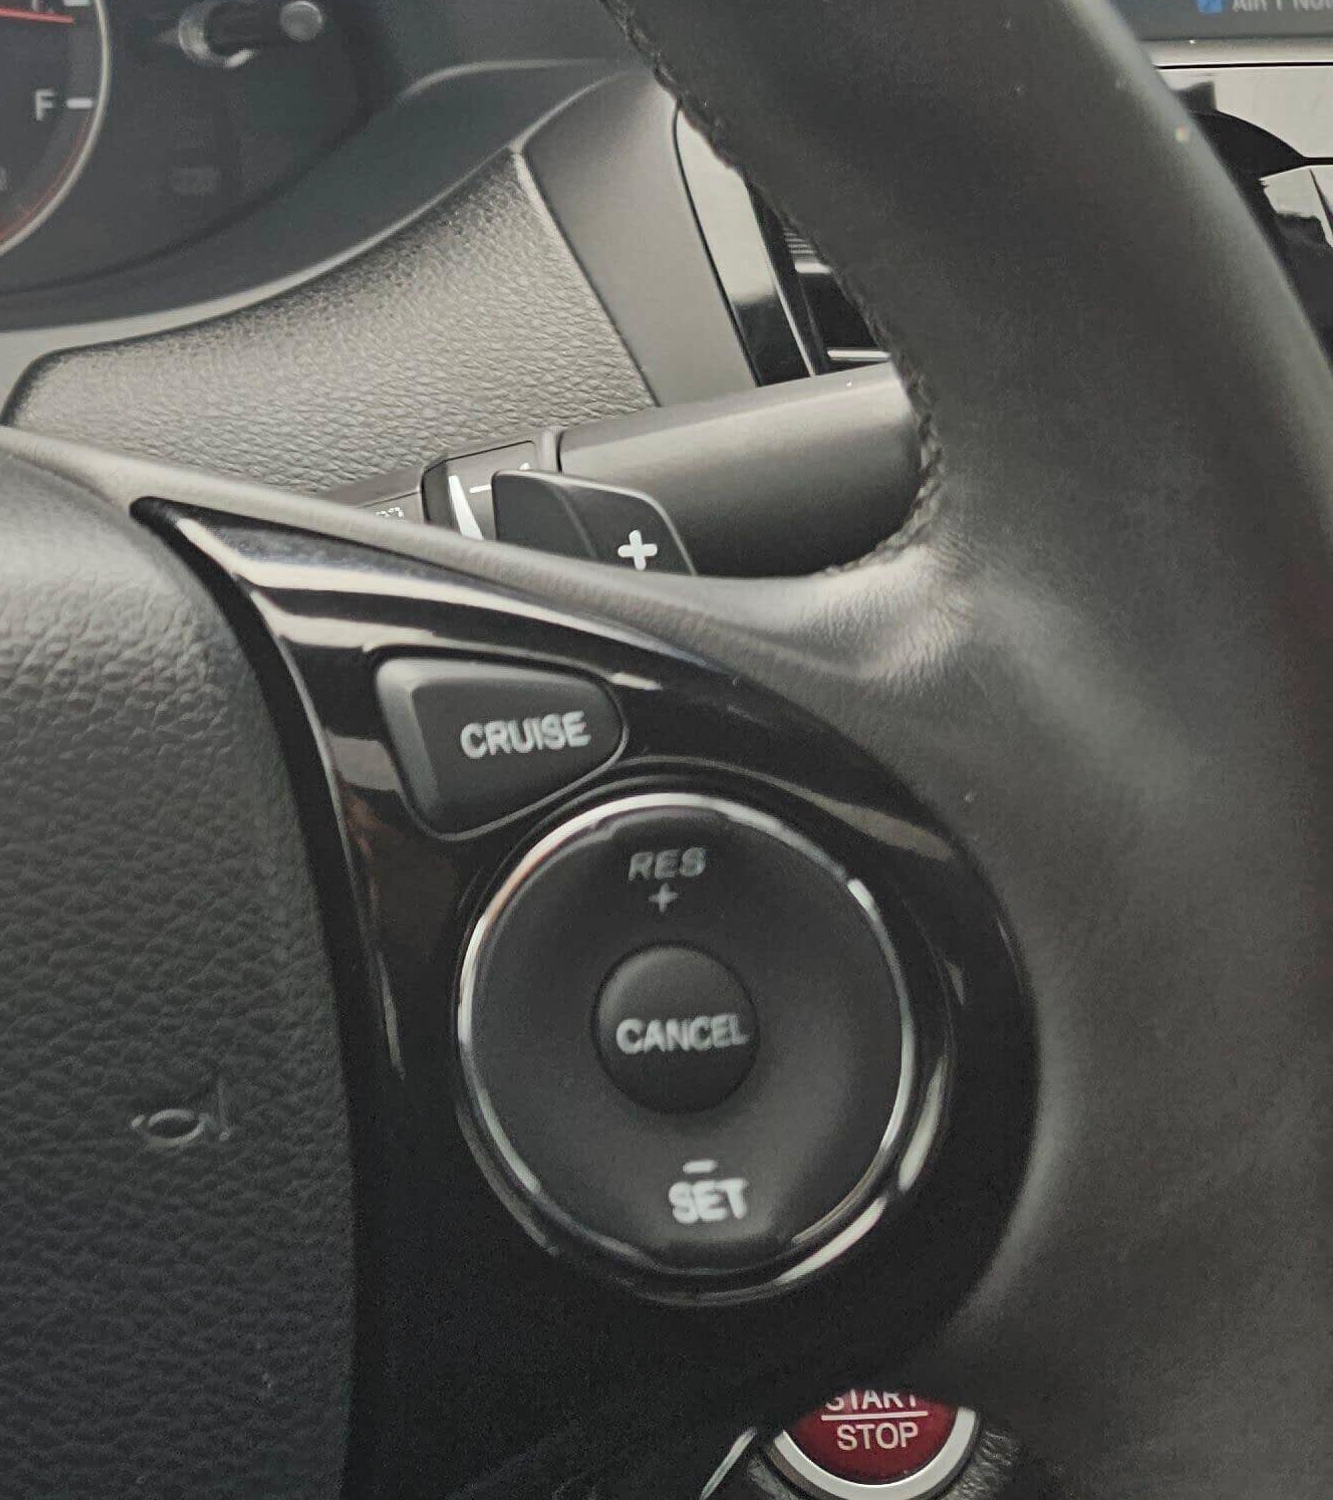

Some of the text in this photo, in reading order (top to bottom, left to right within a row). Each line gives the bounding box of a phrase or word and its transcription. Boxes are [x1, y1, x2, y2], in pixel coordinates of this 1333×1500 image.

[34, 90, 55, 122] F
[460, 710, 591, 760] CRUISE
[628, 847, 706, 880] RES
[616, 1013, 749, 1055] CANCEL
[669, 1177, 749, 1224] SET
[836, 1422, 919, 1451] STOP
